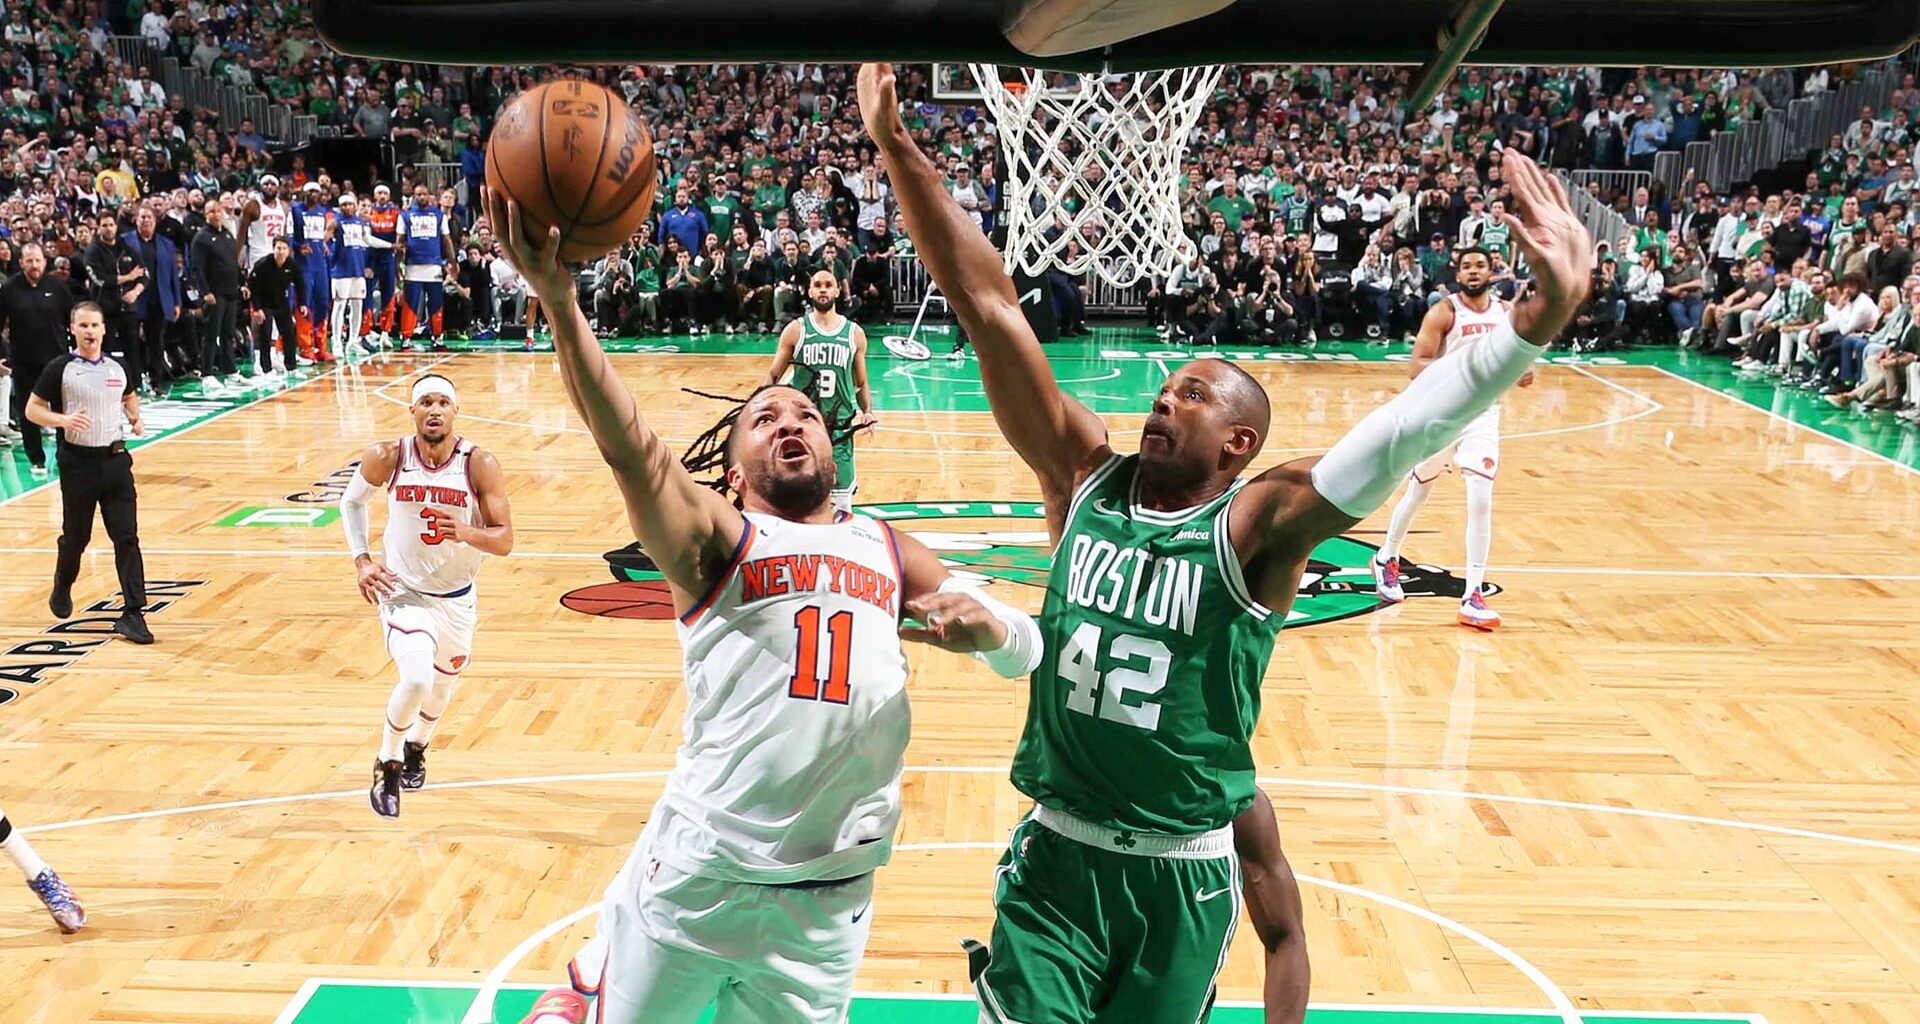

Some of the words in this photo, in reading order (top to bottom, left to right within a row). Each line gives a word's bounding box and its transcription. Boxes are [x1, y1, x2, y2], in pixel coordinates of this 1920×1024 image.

[267, 223, 282, 238] 23
[803, 343, 850, 370] BOSTON
[817, 369, 837, 398] 9
[395, 485, 426, 503] NEW
[426, 485, 468, 508] YORK
[420, 507, 446, 546] 3
[1170, 528, 1210, 542] Amica
[741, 554, 821, 603] NEW
[823, 554, 897, 617] YORK
[1066, 533, 1204, 637] BOSTON
[788, 604, 853, 706] 11
[1057, 621, 1173, 731] 42
